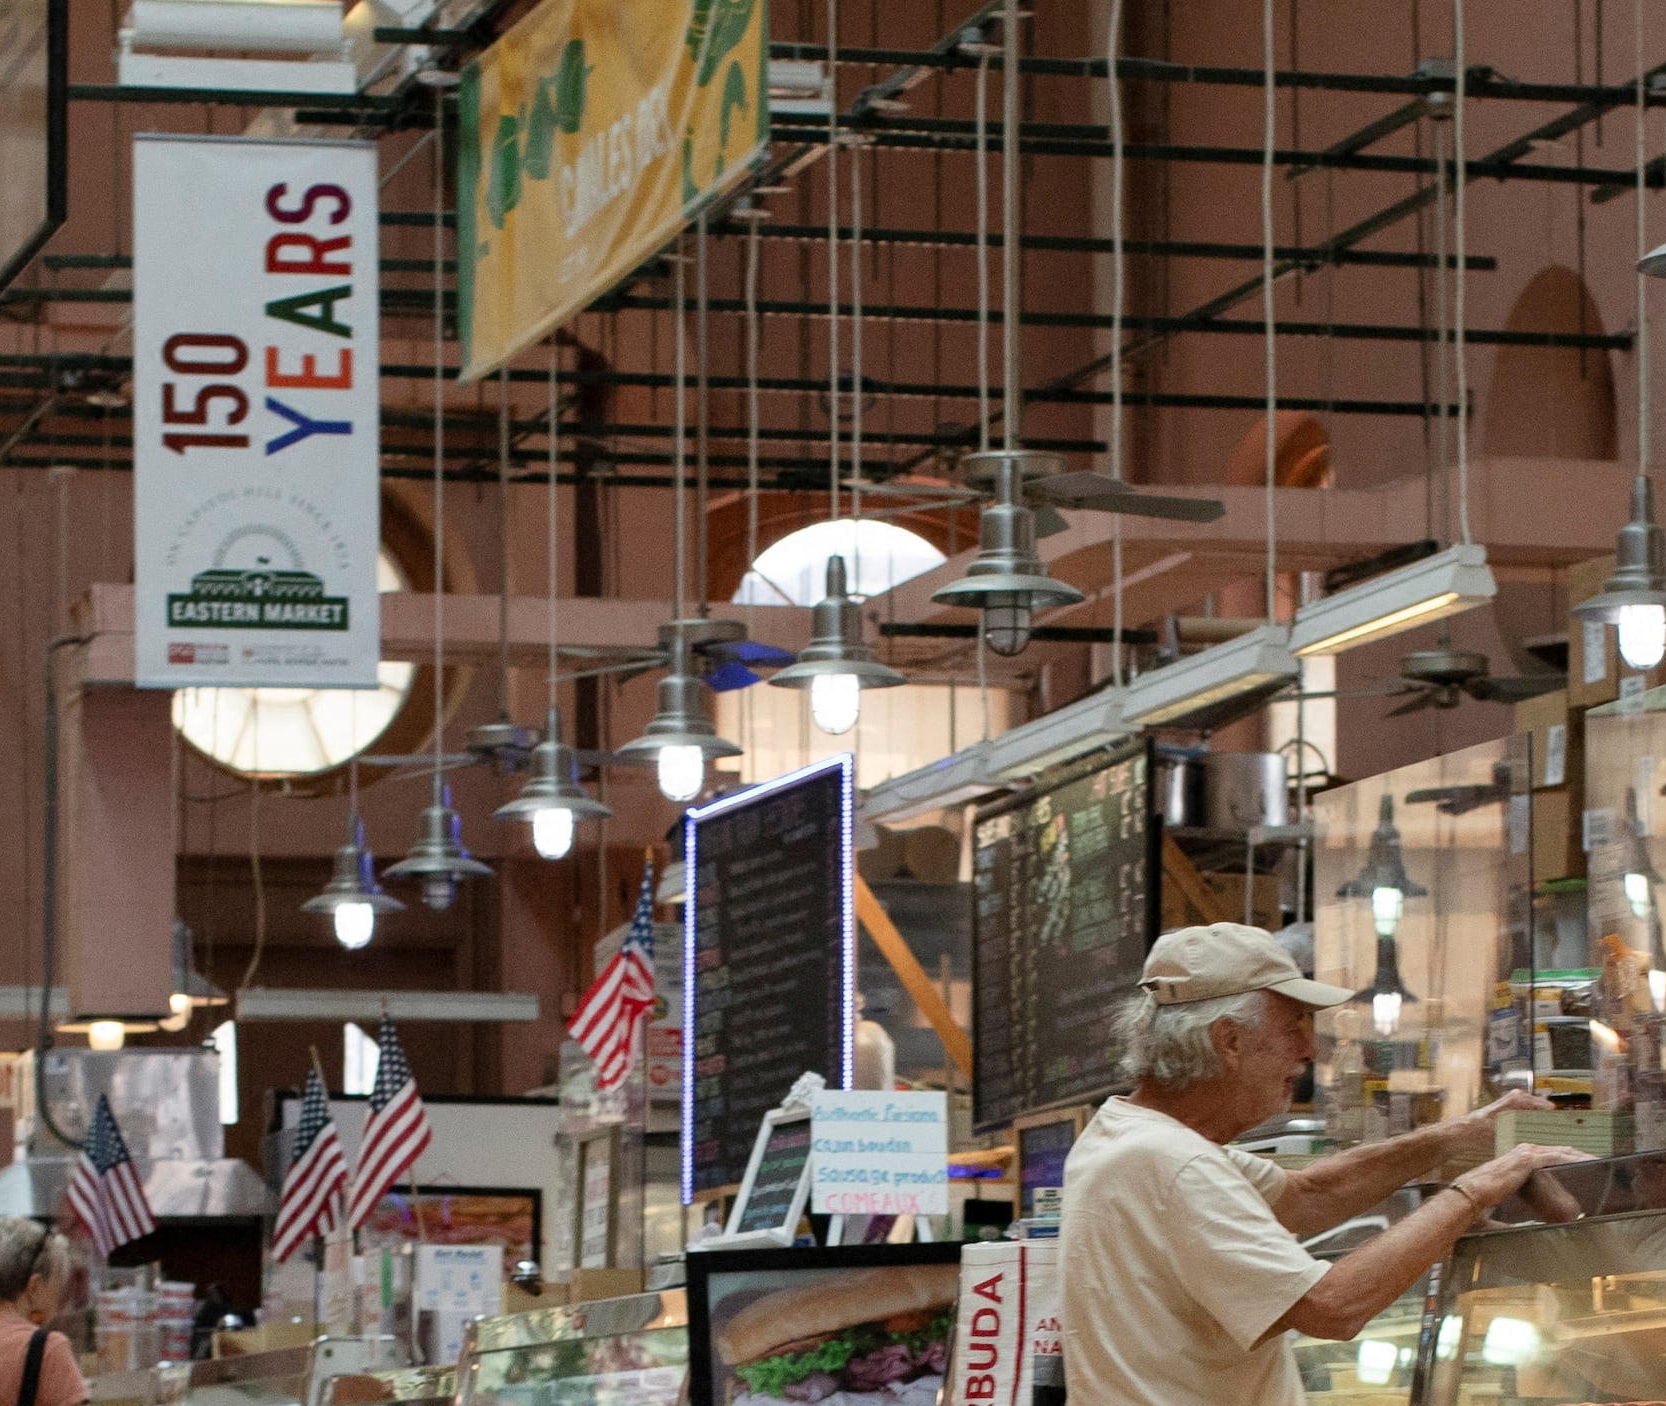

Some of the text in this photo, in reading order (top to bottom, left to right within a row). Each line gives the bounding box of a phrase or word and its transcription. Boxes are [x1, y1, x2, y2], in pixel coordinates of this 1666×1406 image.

[264, 182, 353, 455] YEARS
[162, 332, 251, 454] 150
[171, 601, 344, 623] EASTERN MARKET
